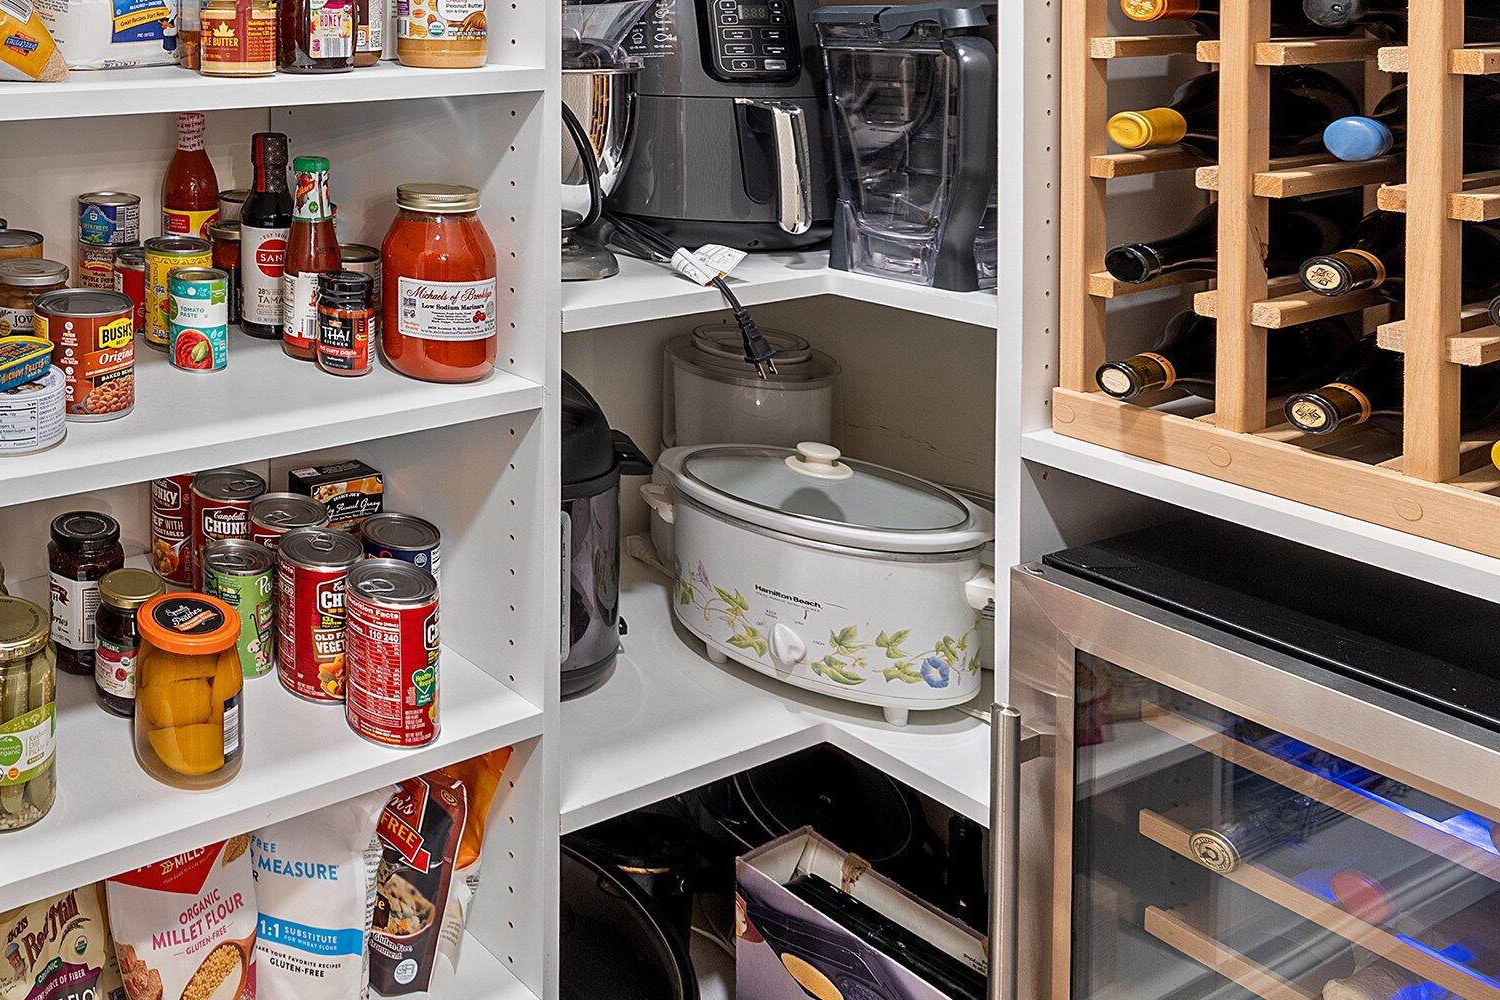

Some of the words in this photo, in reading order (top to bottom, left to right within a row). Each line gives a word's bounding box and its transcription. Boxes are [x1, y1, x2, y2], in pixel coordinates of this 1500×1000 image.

[320, 15, 341, 26] HONEY
[213, 38, 239, 47] BUTTER
[407, 286, 448, 300] Michaels
[450, 291, 460, 305] of
[102, 322, 132, 344] BUSH'S
[322, 326, 350, 341] THAI
[102, 372, 121, 381] BAKED
[165, 521, 184, 531] WITH
[755, 584, 792, 601] Hamilton
[793, 597, 821, 609] Beach
[376, 610, 399, 619] Facts
[369, 629, 381, 639] 110
[383, 632, 399, 642] 240
[102, 640, 120, 653] ORGANIC
[380, 813, 417, 849] FREE
[251, 835, 277, 854] FREE
[257, 859, 337, 881] MEASURE
[179, 889, 220, 924] ORGANIC
[153, 919, 202, 950] MILLET
[205, 892, 244, 930] FLOUR
[260, 920, 280, 938] 1:1
[21, 911, 49, 973] Red
[186, 925, 227, 955] GLUTEN-FREE
[284, 926, 338, 944] SUBSTITUTE
[269, 957, 325, 978] GLUTEN-FREE
[270, 950, 287, 960] YOUR
[288, 954, 317, 969] FAVORITE
[38, 960, 58, 983] ORGANIC
[44, 980, 59, 997] SOURCE
[60, 975, 67, 984] OF
[69, 969, 86, 981] FIBER
